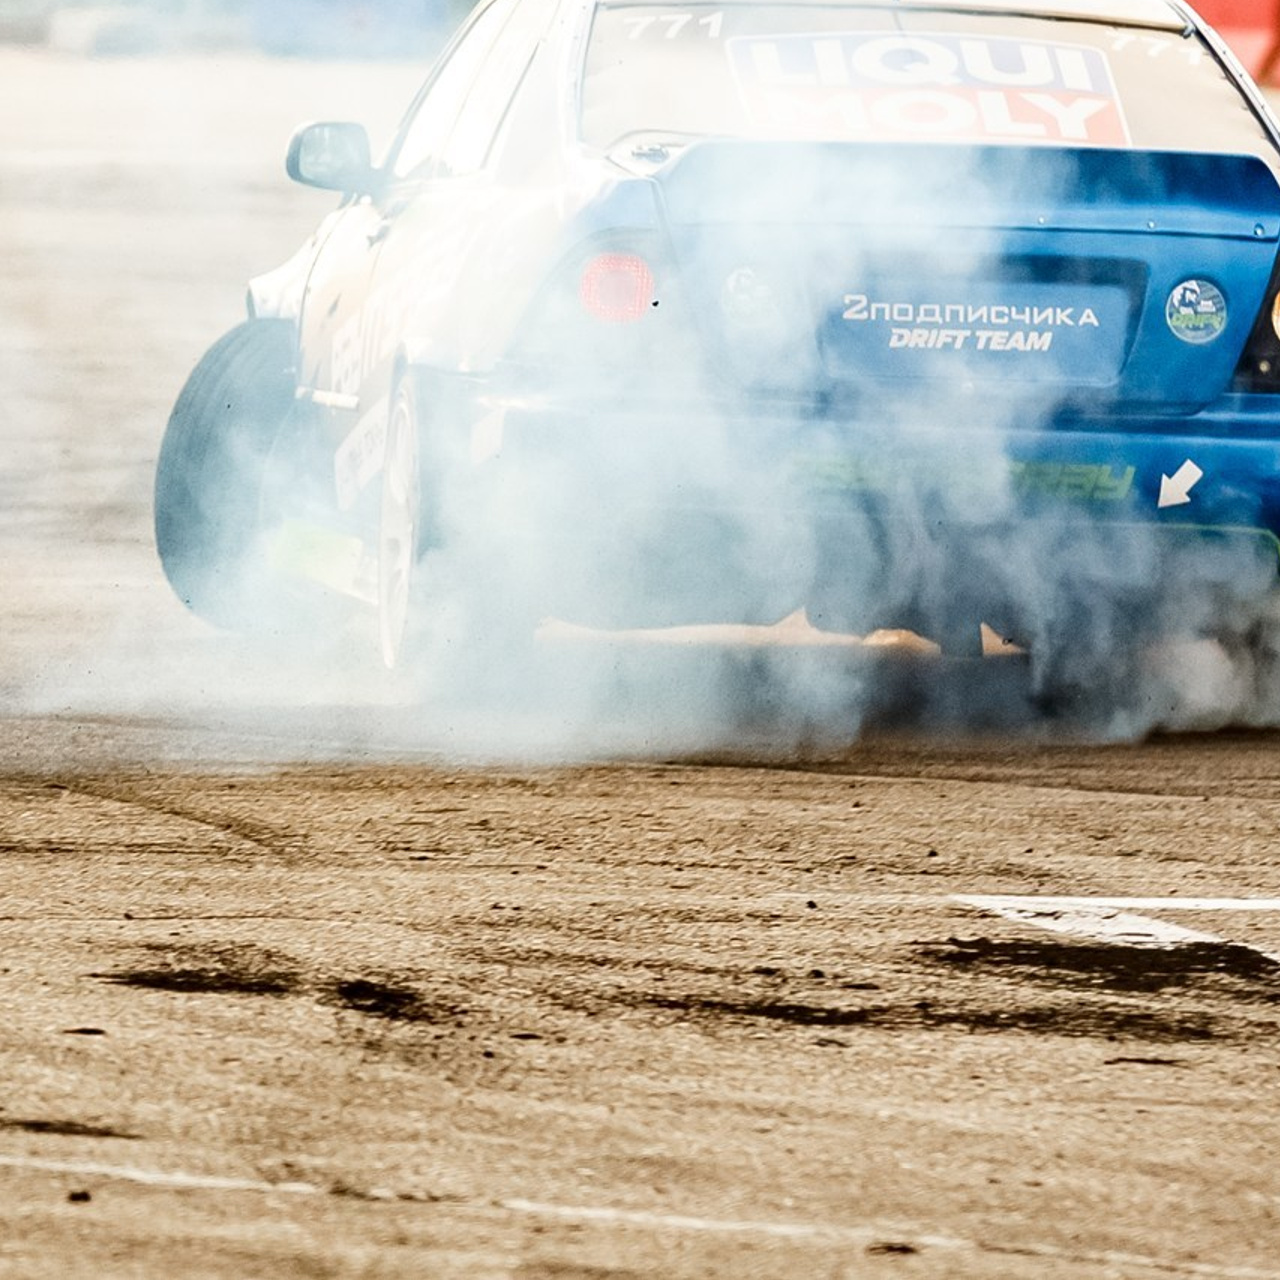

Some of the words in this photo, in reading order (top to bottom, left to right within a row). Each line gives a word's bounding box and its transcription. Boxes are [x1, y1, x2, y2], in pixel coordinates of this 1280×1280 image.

[624, 11, 722, 40] 771
[748, 37, 1097, 91] LIQUI
[766, 90, 1113, 140] MOLY
[888, 327, 971, 350] DRIFT
[975, 330, 1053, 352] TEAM
